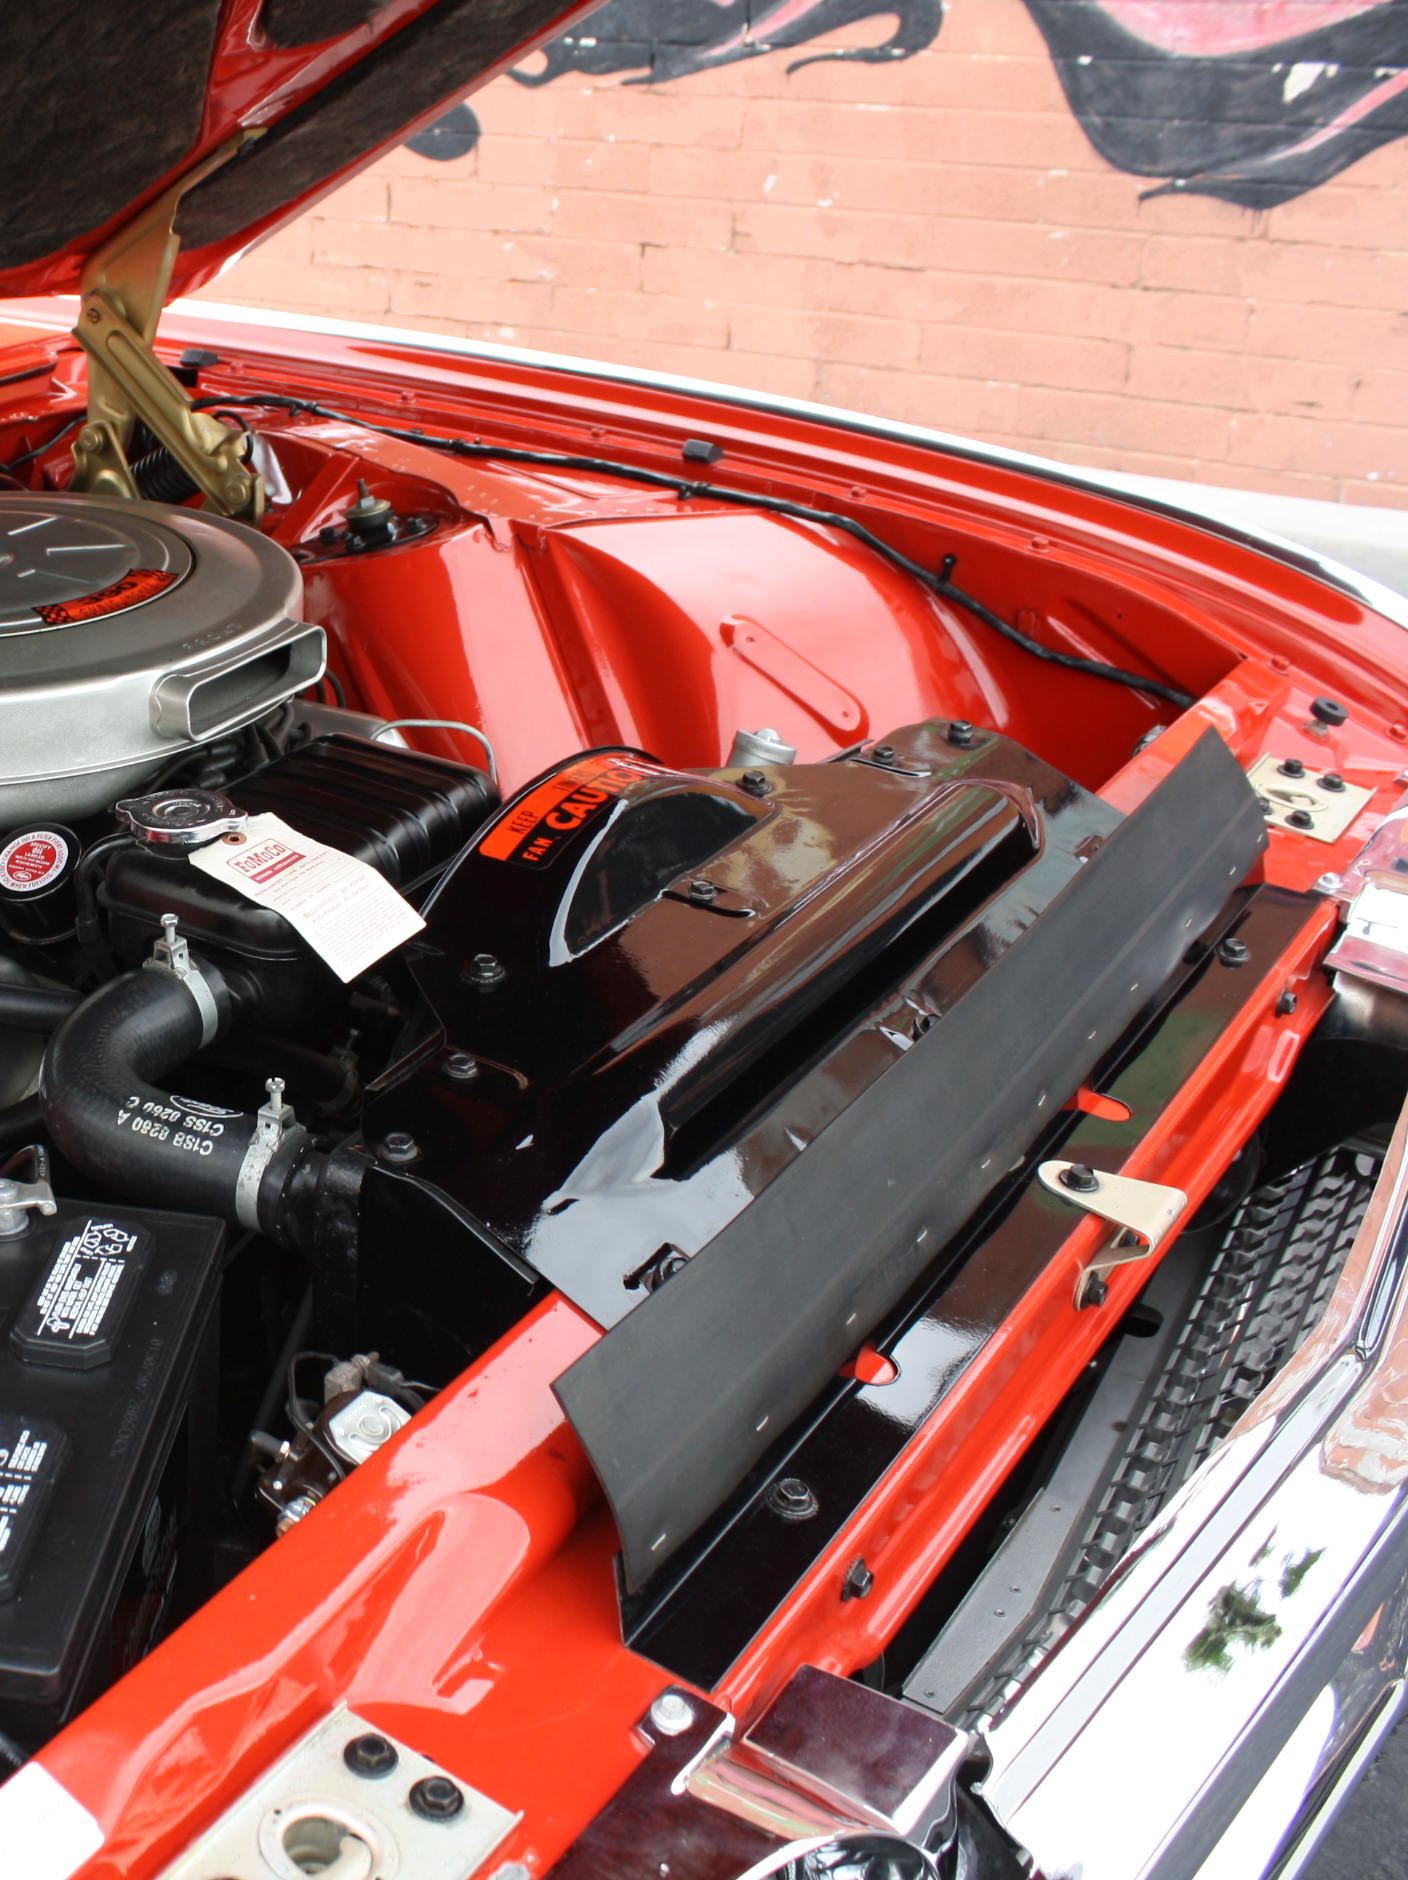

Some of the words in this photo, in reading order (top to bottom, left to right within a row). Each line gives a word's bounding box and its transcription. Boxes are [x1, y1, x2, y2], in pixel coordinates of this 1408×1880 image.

[545, 768, 645, 831] CAUTIO
[506, 810, 540, 835] KEEP
[32, 847, 44, 855] OIL
[234, 842, 287, 873] FoMoCo
[125, 1096, 141, 1109] C
[117, 1109, 132, 1126] A
